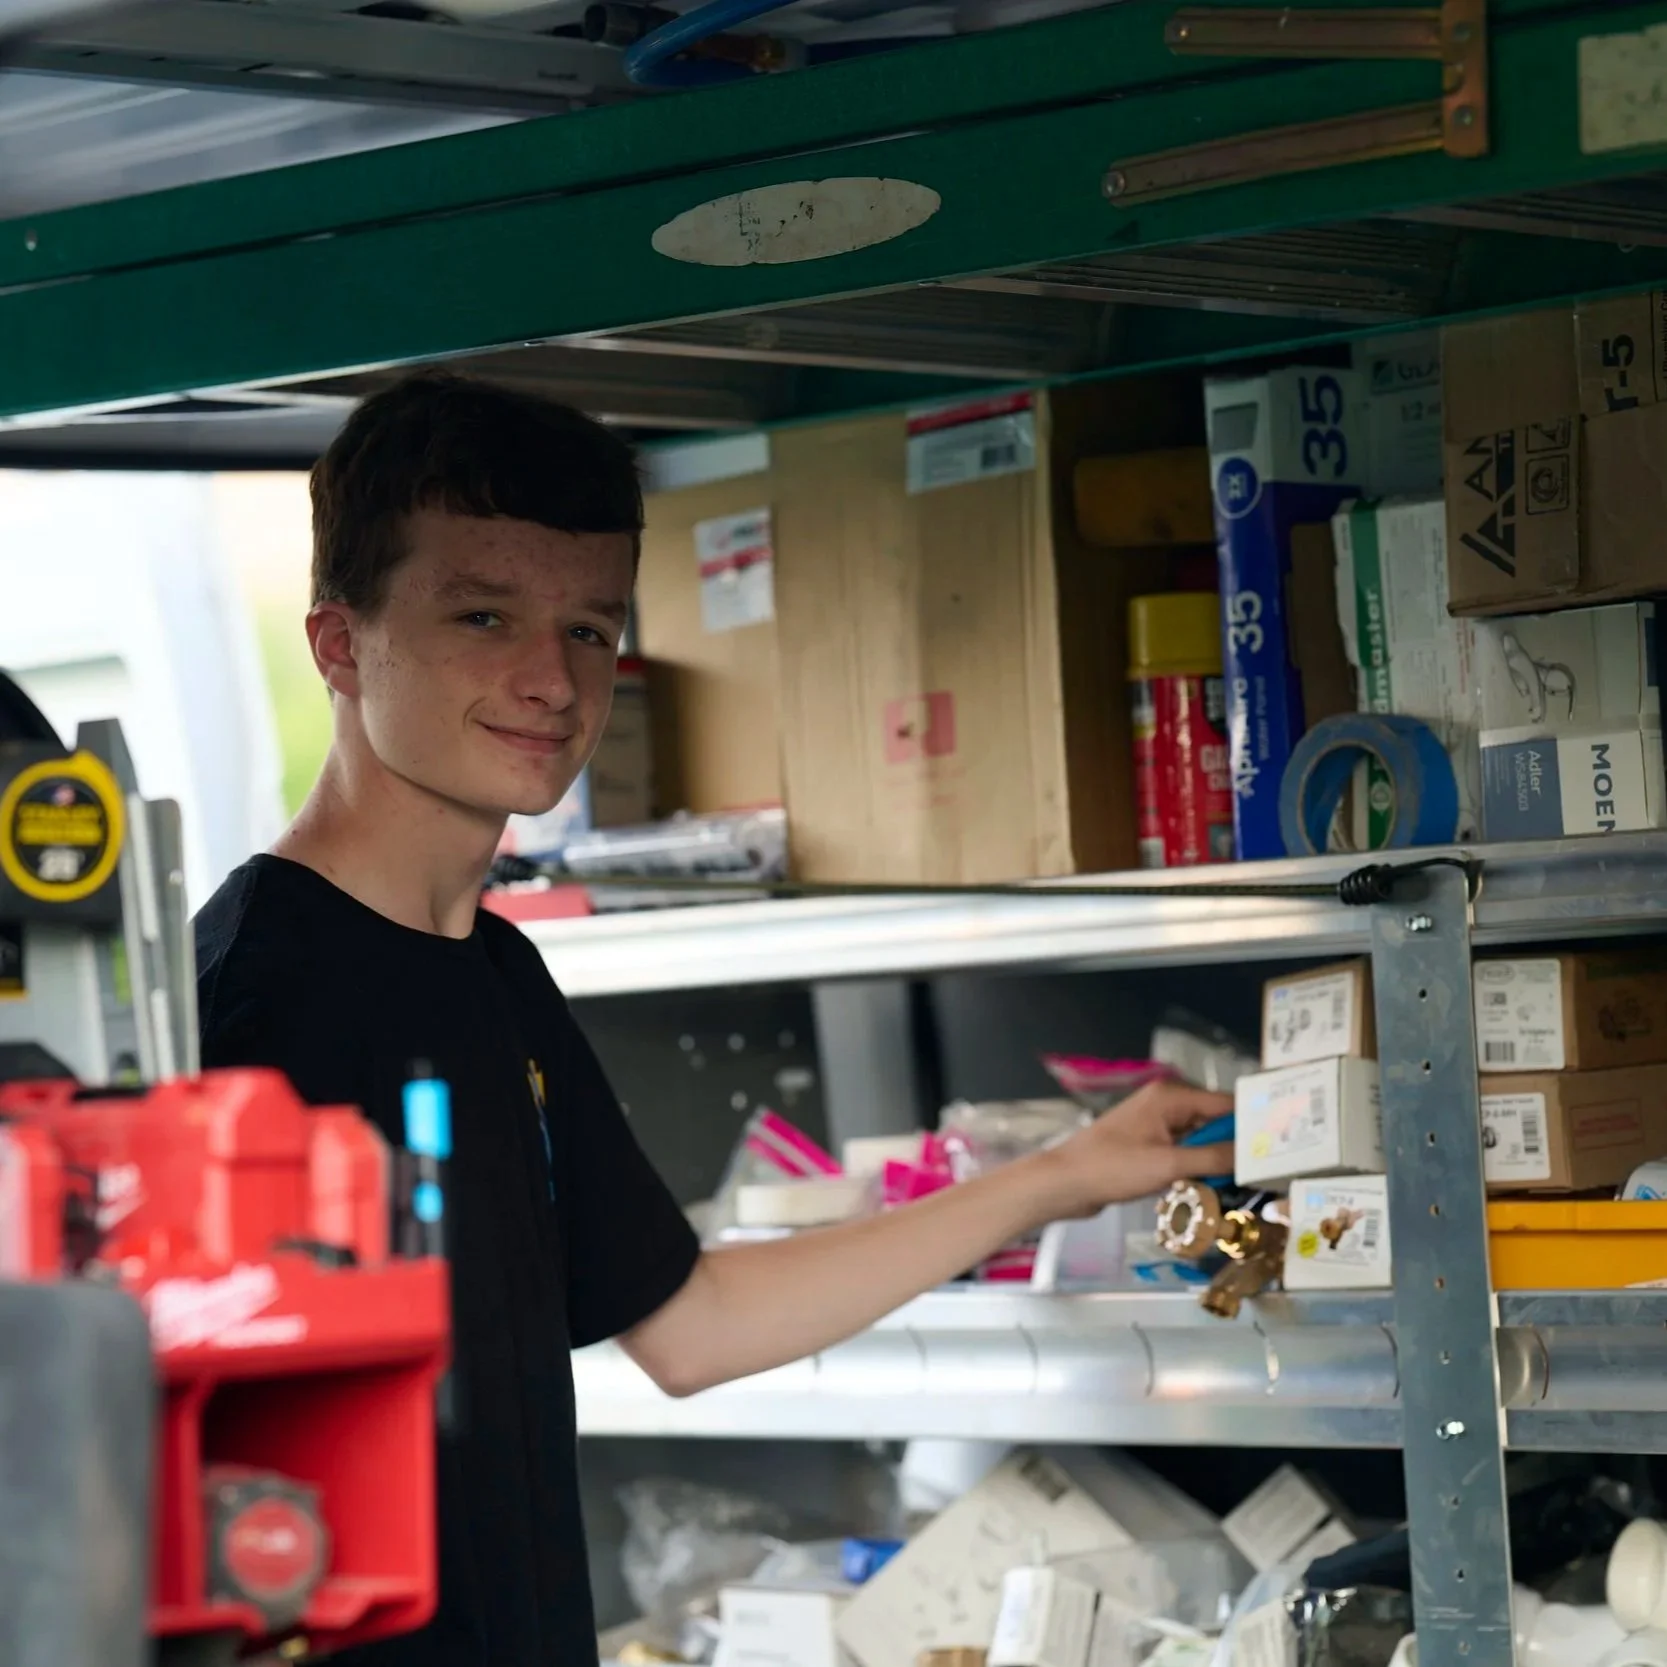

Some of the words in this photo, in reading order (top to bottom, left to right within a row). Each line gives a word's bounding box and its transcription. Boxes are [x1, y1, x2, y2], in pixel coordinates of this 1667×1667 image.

[1297, 374, 1348, 479] 35
[1226, 589, 1264, 655] 35
[1528, 749, 1543, 795] Adler
